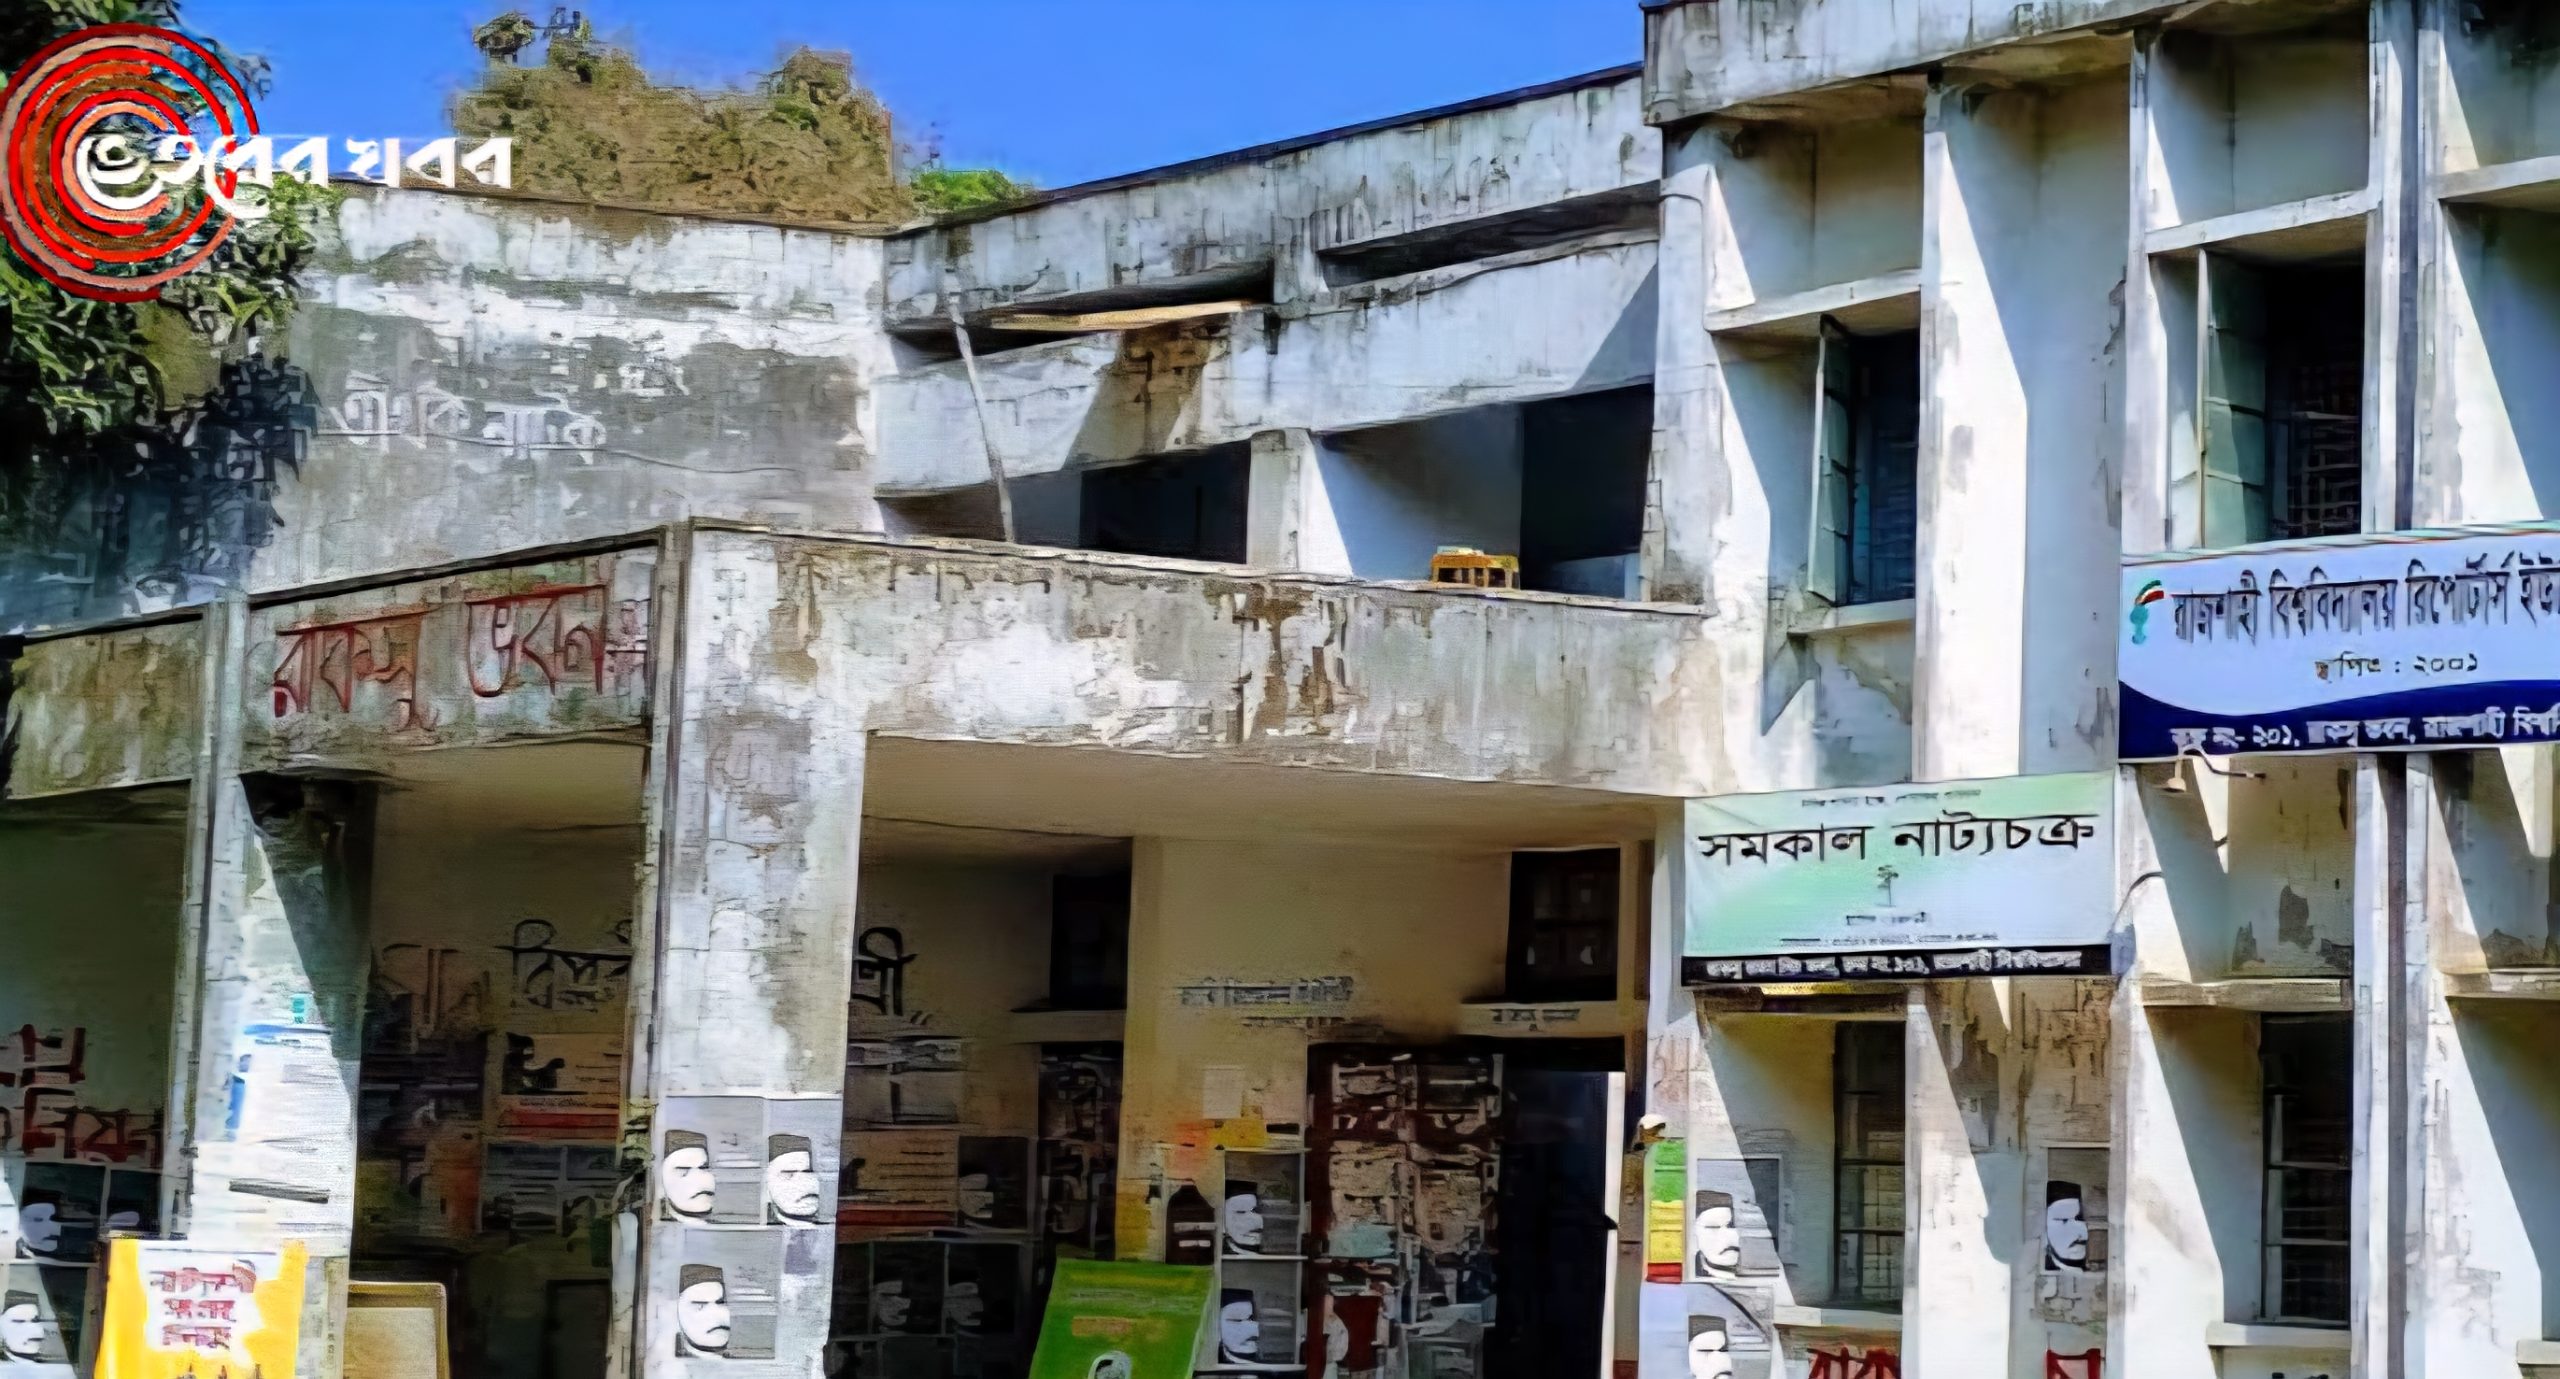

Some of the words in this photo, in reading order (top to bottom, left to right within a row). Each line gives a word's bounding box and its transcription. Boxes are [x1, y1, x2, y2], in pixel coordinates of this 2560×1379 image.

[2171, 568, 2262, 645] রাজশাহী
[2268, 566, 2398, 637] বিশ্ববিদ্যালয়
[2405, 551, 2515, 626] রিপোর্টার্স
[2519, 551, 2560, 628] ইউ
[2413, 652, 2478, 677] ২০০১
[1698, 823, 1875, 866] সমকাল
[1891, 809, 2100, 857] নাট্যচক্র
